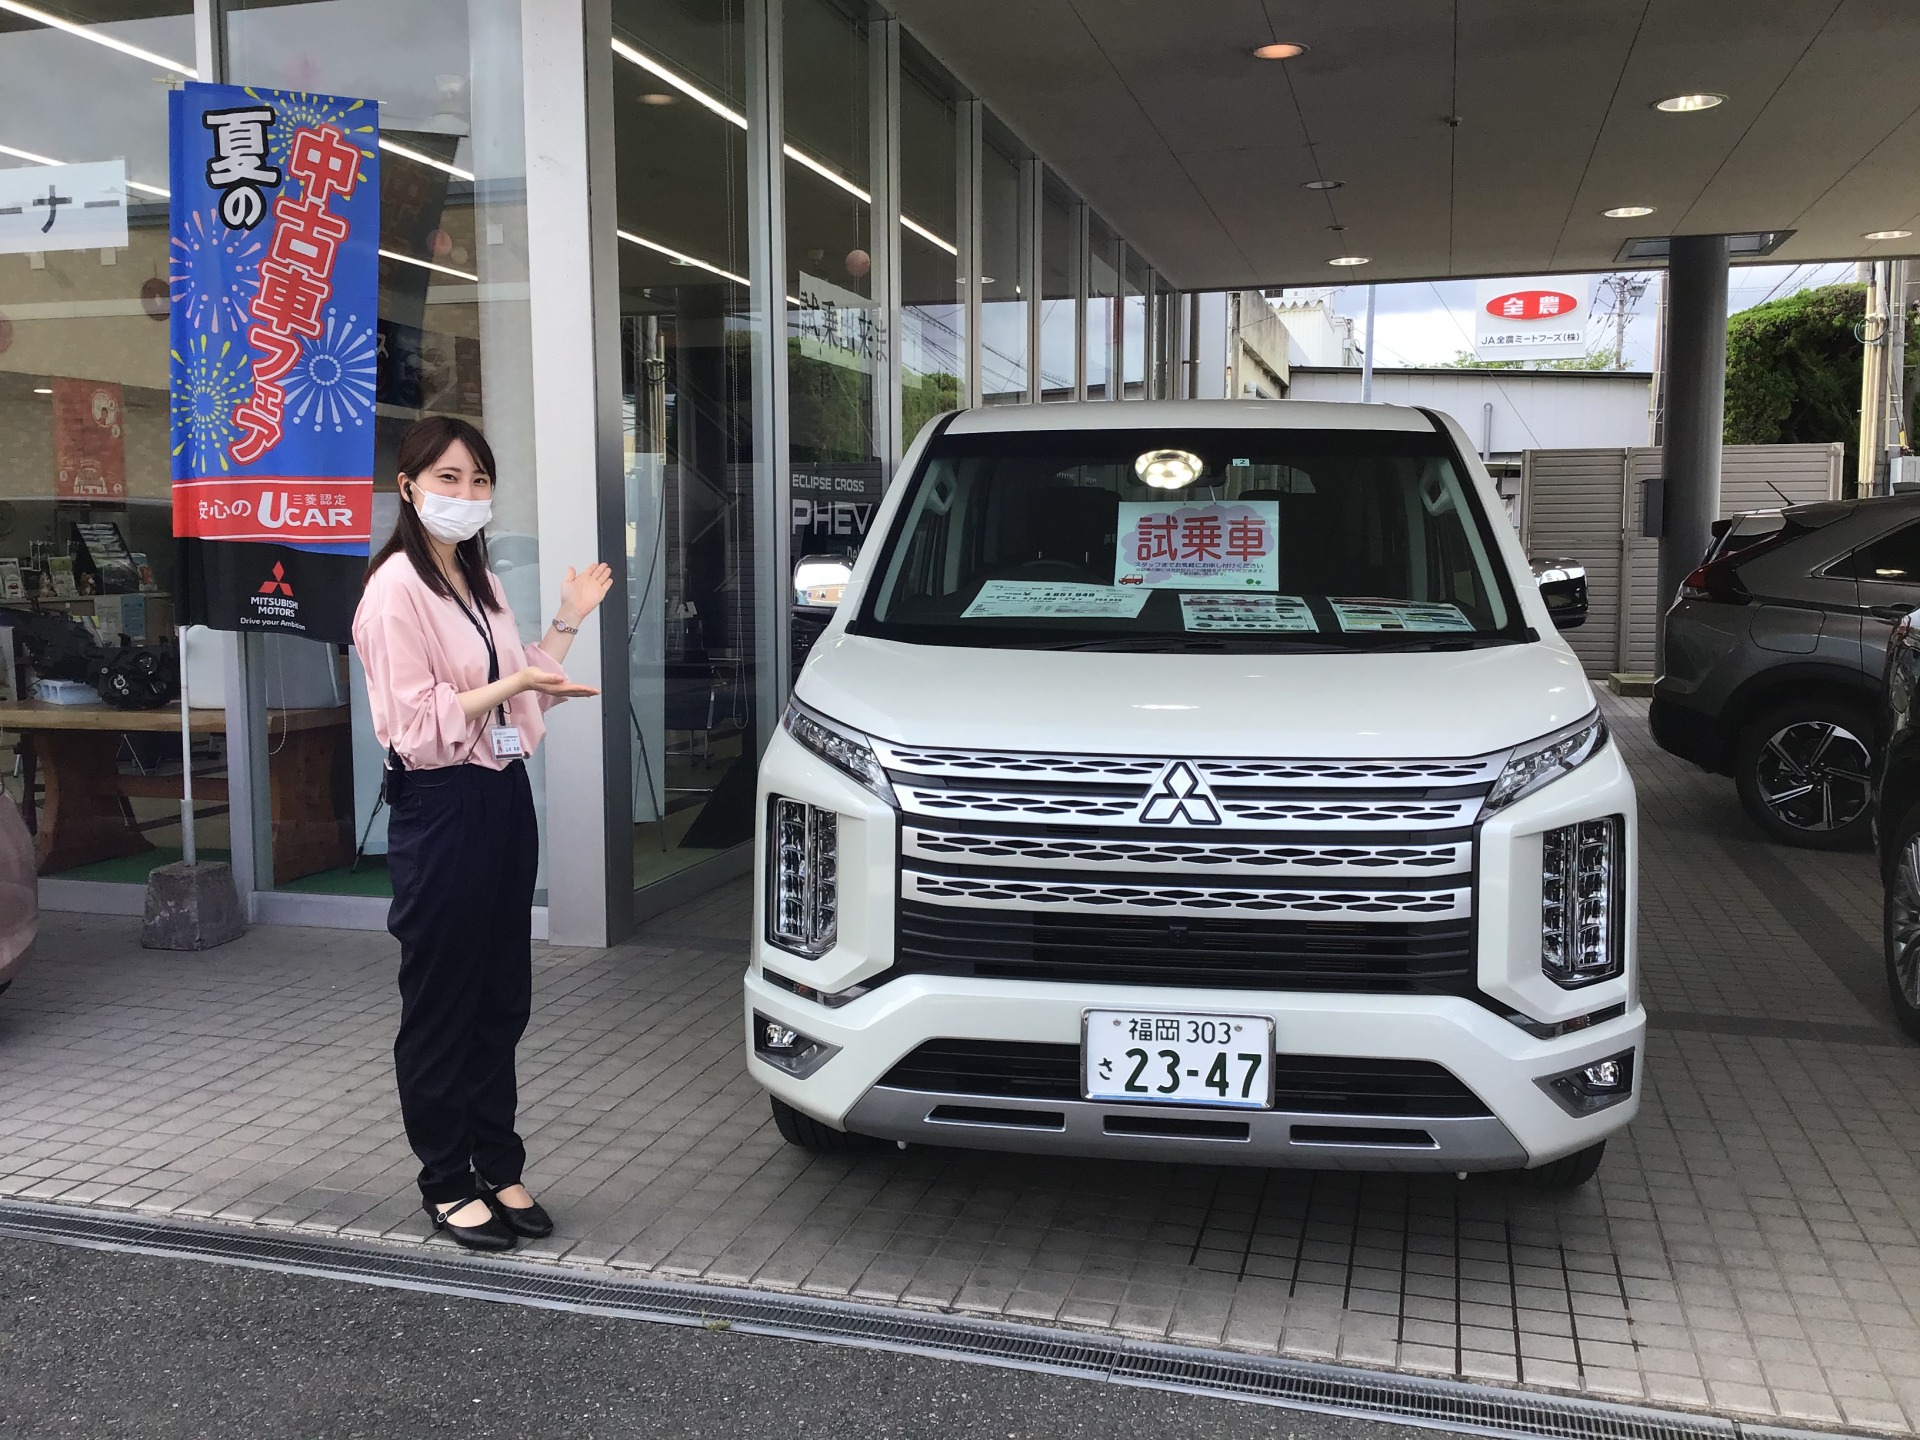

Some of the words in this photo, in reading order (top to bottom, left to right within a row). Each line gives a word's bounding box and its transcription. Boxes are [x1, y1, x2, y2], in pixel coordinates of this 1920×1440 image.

[204, 108, 279, 228] 夏の
[229, 124, 360, 464] 中古車フェア
[1503, 296, 1560, 315] 全農
[792, 474, 831, 490] ECLIPSE
[835, 478, 865, 492] CROSS
[293, 494, 346, 506] 三菱認定
[792, 499, 873, 535] PHEV
[1137, 515, 1266, 562] 試乗車
[251, 596, 299, 610] MITSUBISHI
[258, 606, 295, 618] MOTORS
[240, 617, 261, 625] Drive
[261, 619, 279, 629] your
[280, 619, 306, 631] Ambition
[1128, 1018, 1180, 1042] 福岡
[1186, 1020, 1232, 1045] 303
[1098, 1057, 1113, 1081] さ
[1124, 1047, 1262, 1098] 23-47
